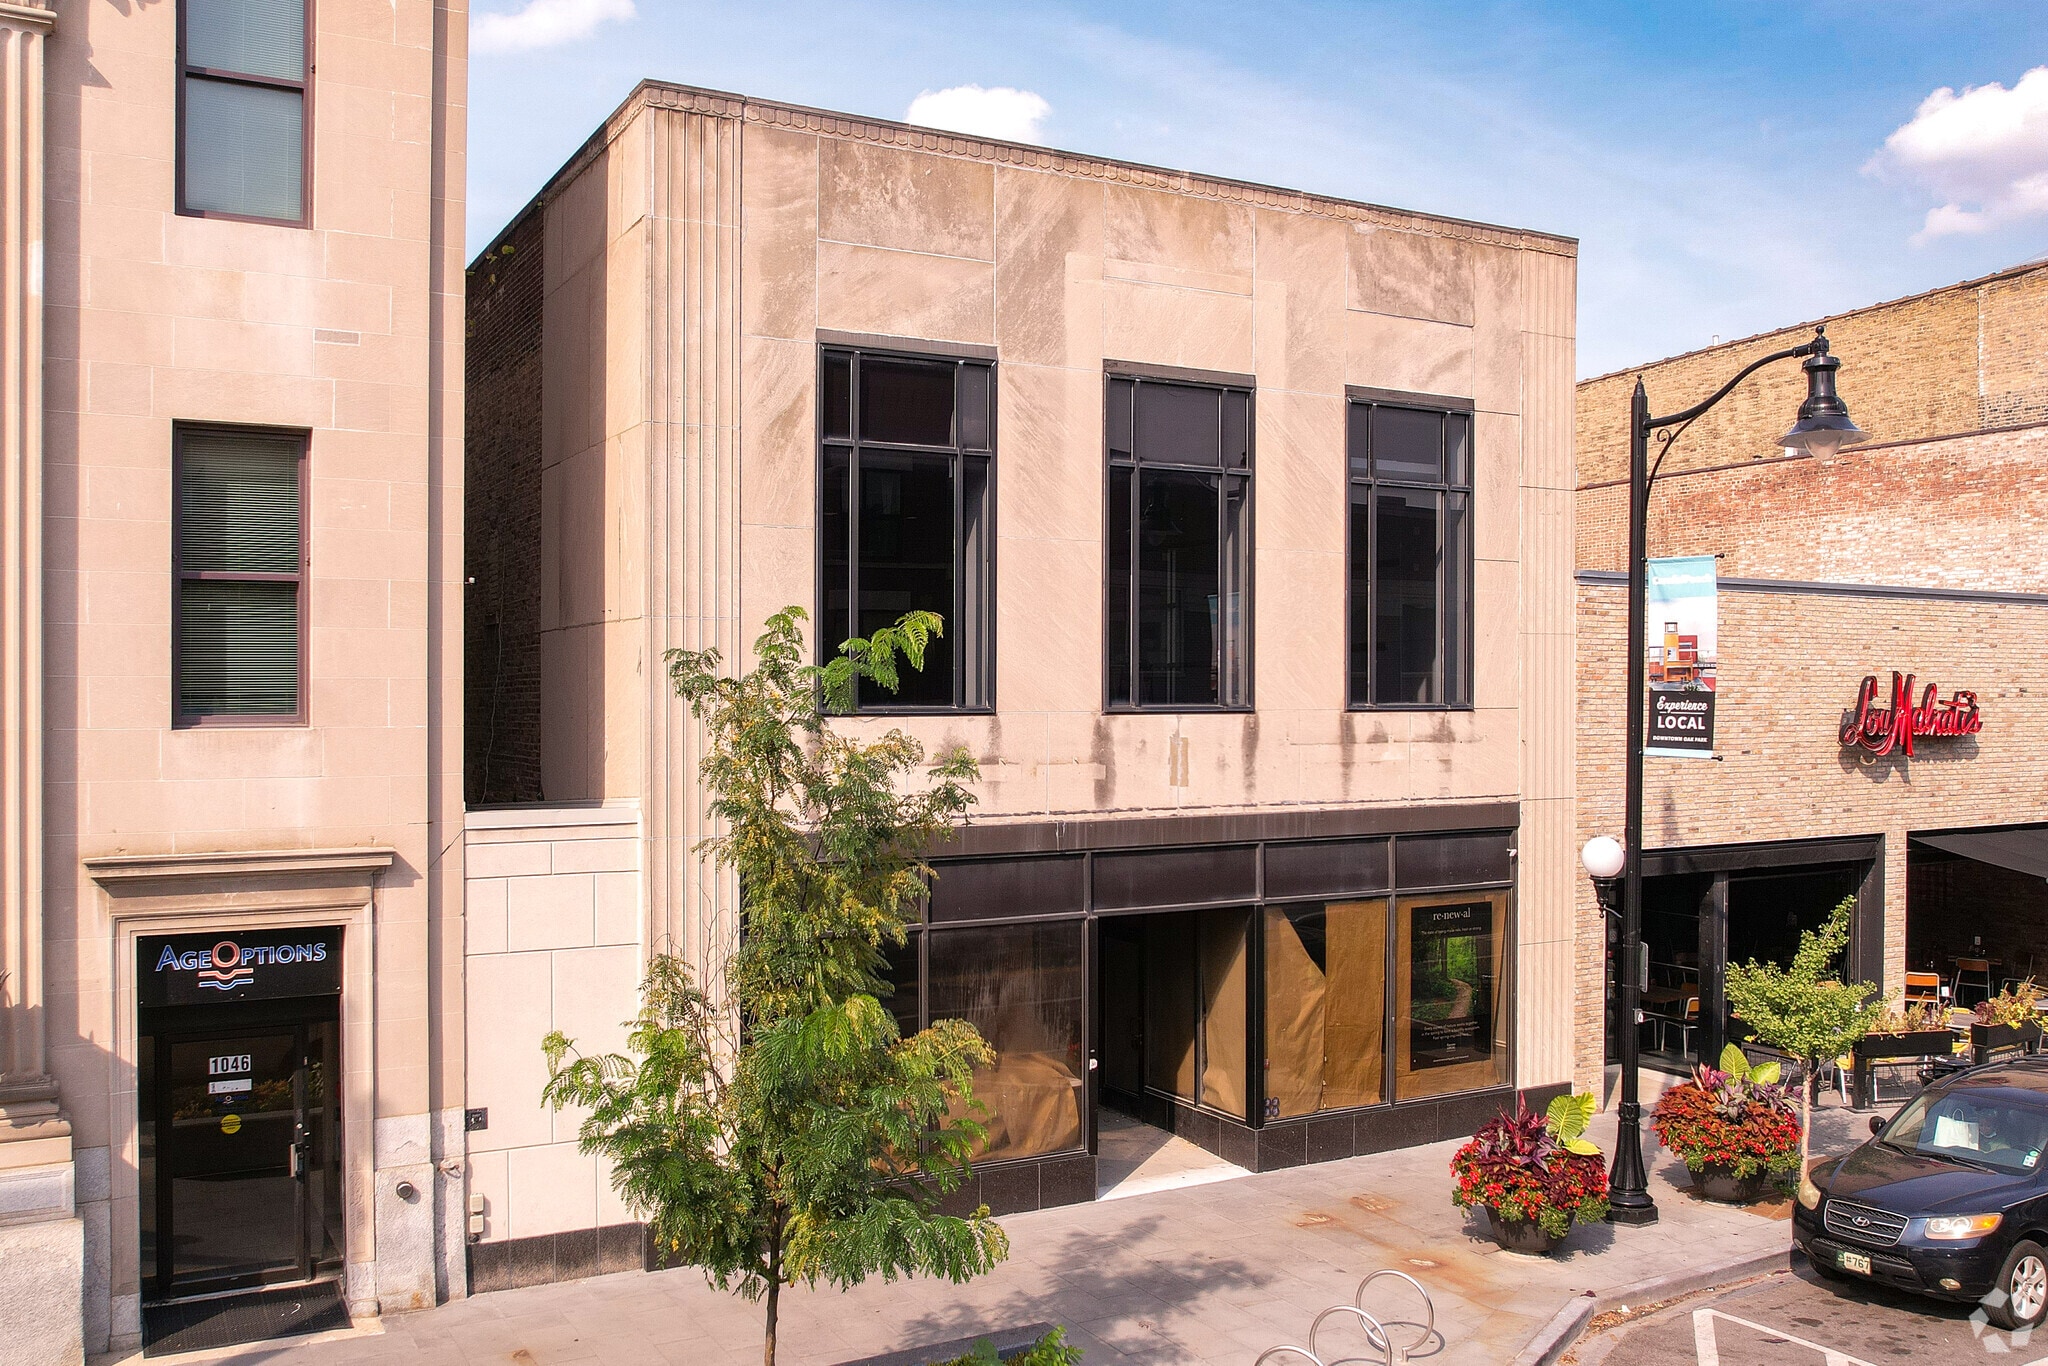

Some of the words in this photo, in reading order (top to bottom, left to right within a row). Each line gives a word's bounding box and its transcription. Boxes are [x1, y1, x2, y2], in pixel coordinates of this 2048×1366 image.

[1656, 695, 1708, 714] Experience
[1838, 675, 1892, 751] Lou
[1657, 715, 1706, 730] LOCAL
[211, 1056, 250, 1073] 1046
[1846, 1255, 1869, 1270] #767
